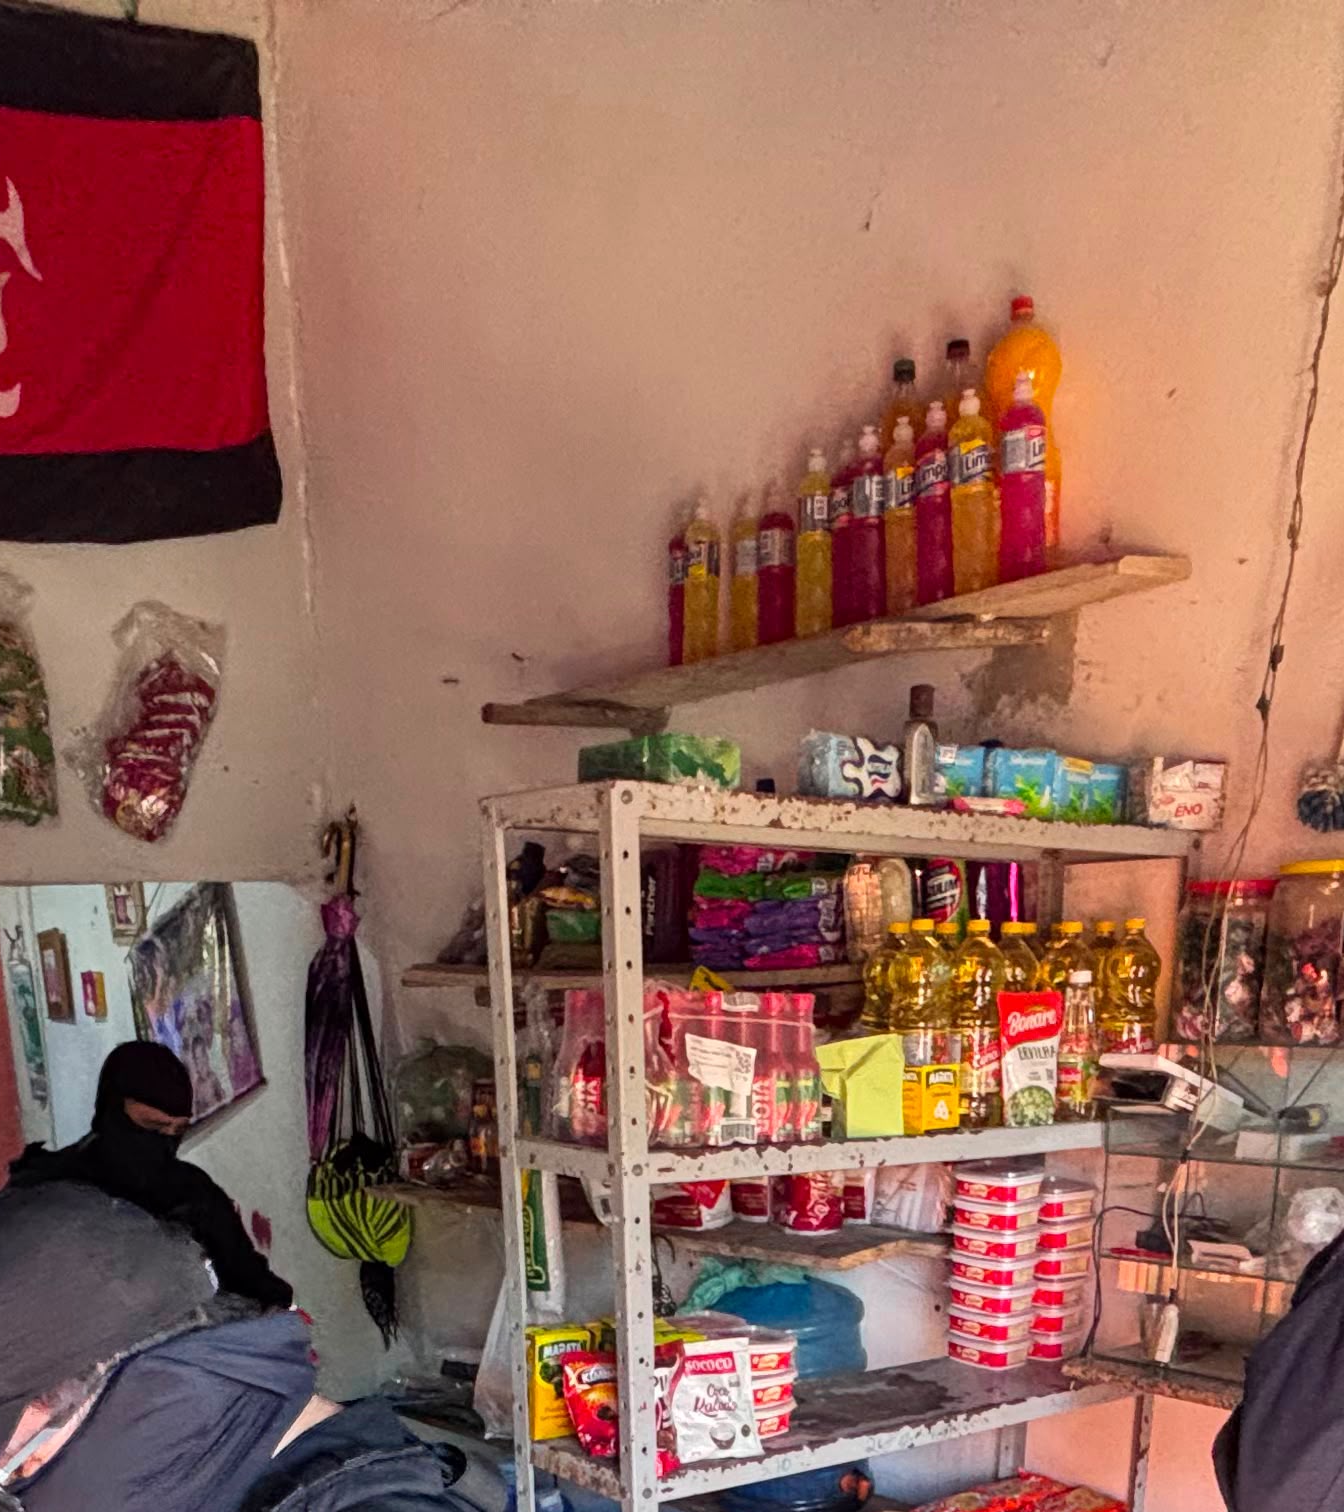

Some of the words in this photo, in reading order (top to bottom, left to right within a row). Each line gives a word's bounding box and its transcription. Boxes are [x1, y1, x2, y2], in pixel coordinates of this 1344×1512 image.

[1175, 803, 1203, 818] ENO
[1008, 1008, 1057, 1036] Bonare
[1017, 1045, 1056, 1061] ERVILHA
